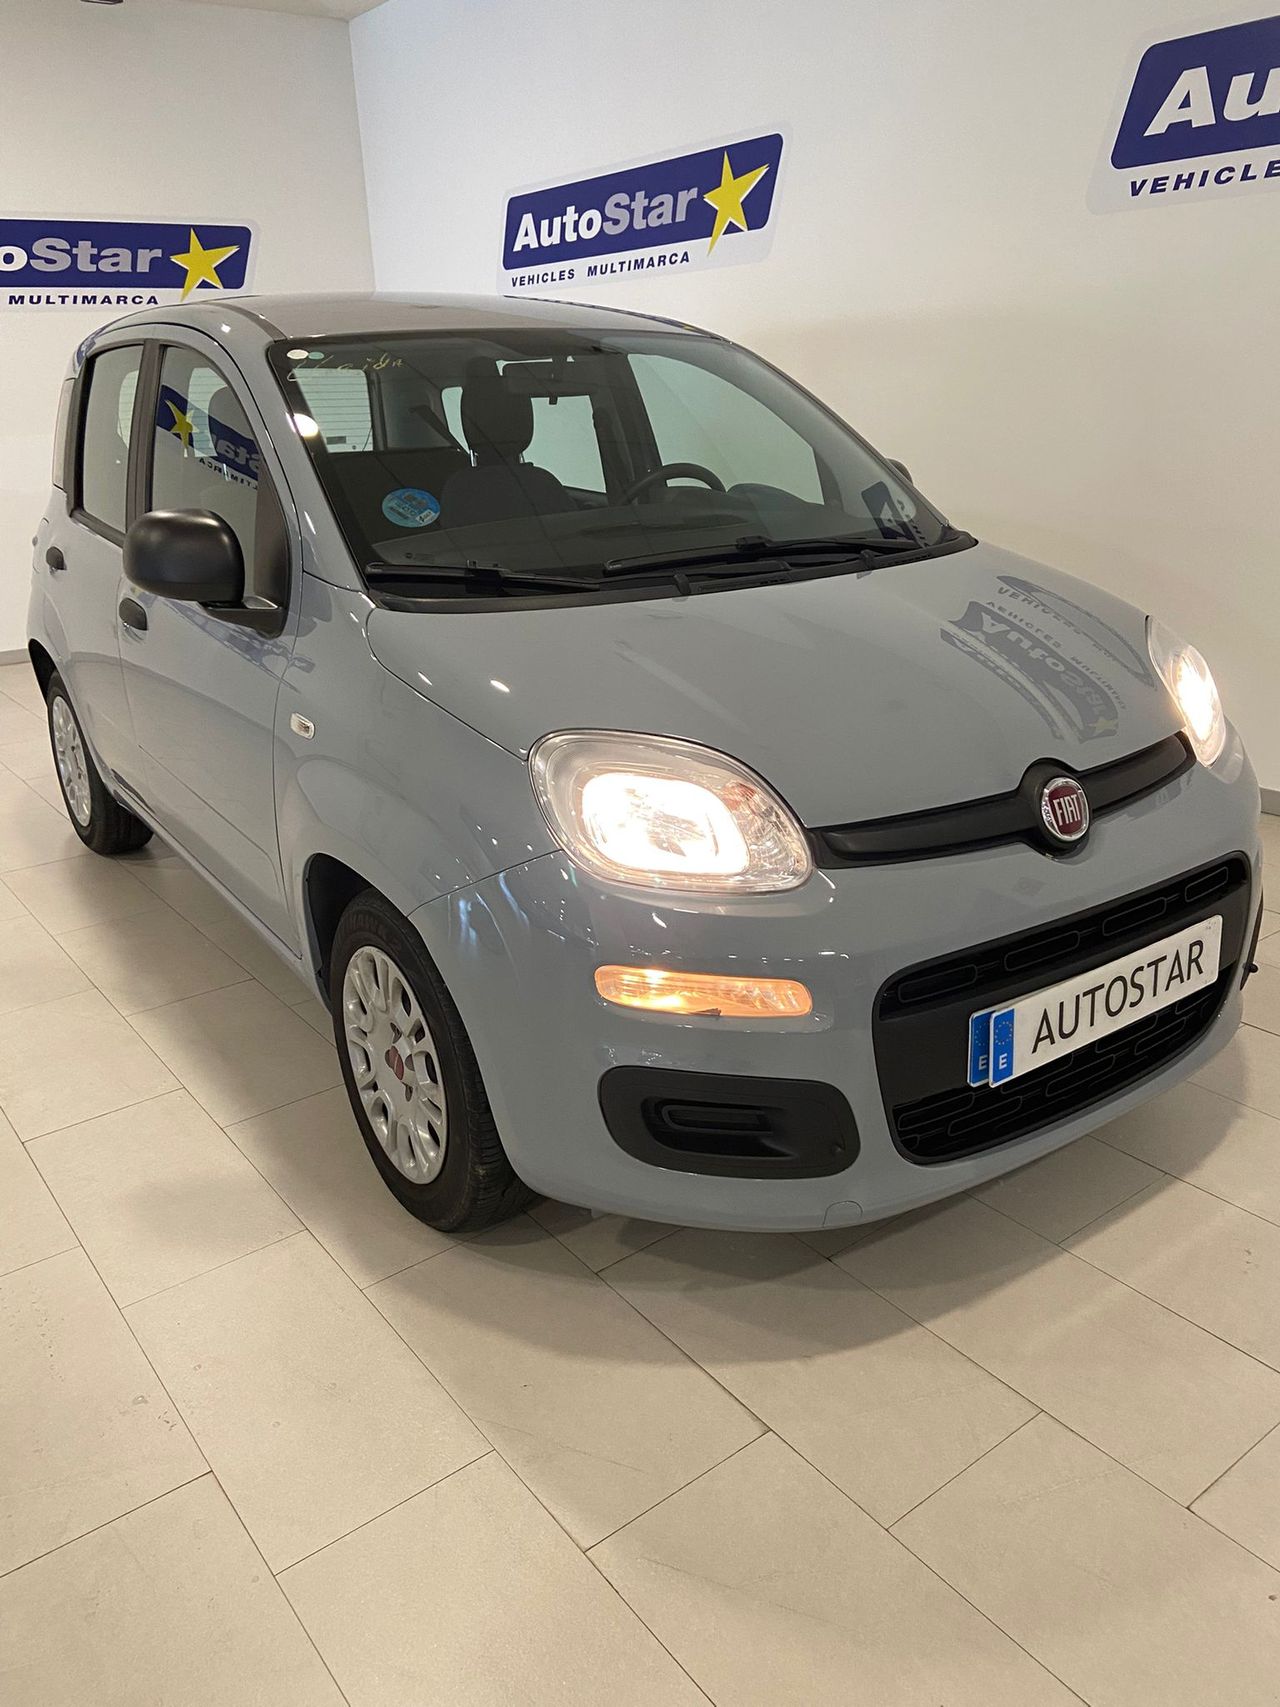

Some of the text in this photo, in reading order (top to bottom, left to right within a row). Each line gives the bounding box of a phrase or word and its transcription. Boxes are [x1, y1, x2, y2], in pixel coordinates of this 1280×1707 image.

[512, 187, 698, 251] AutoStar
[511, 251, 690, 287] VEHICLES MULTIMARCA
[8, 295, 159, 305] MULTIMARCA
[1052, 794, 1081, 826] FIAT
[999, 939, 1204, 1070] E AUTOSTAR
[978, 1054, 988, 1070] E
